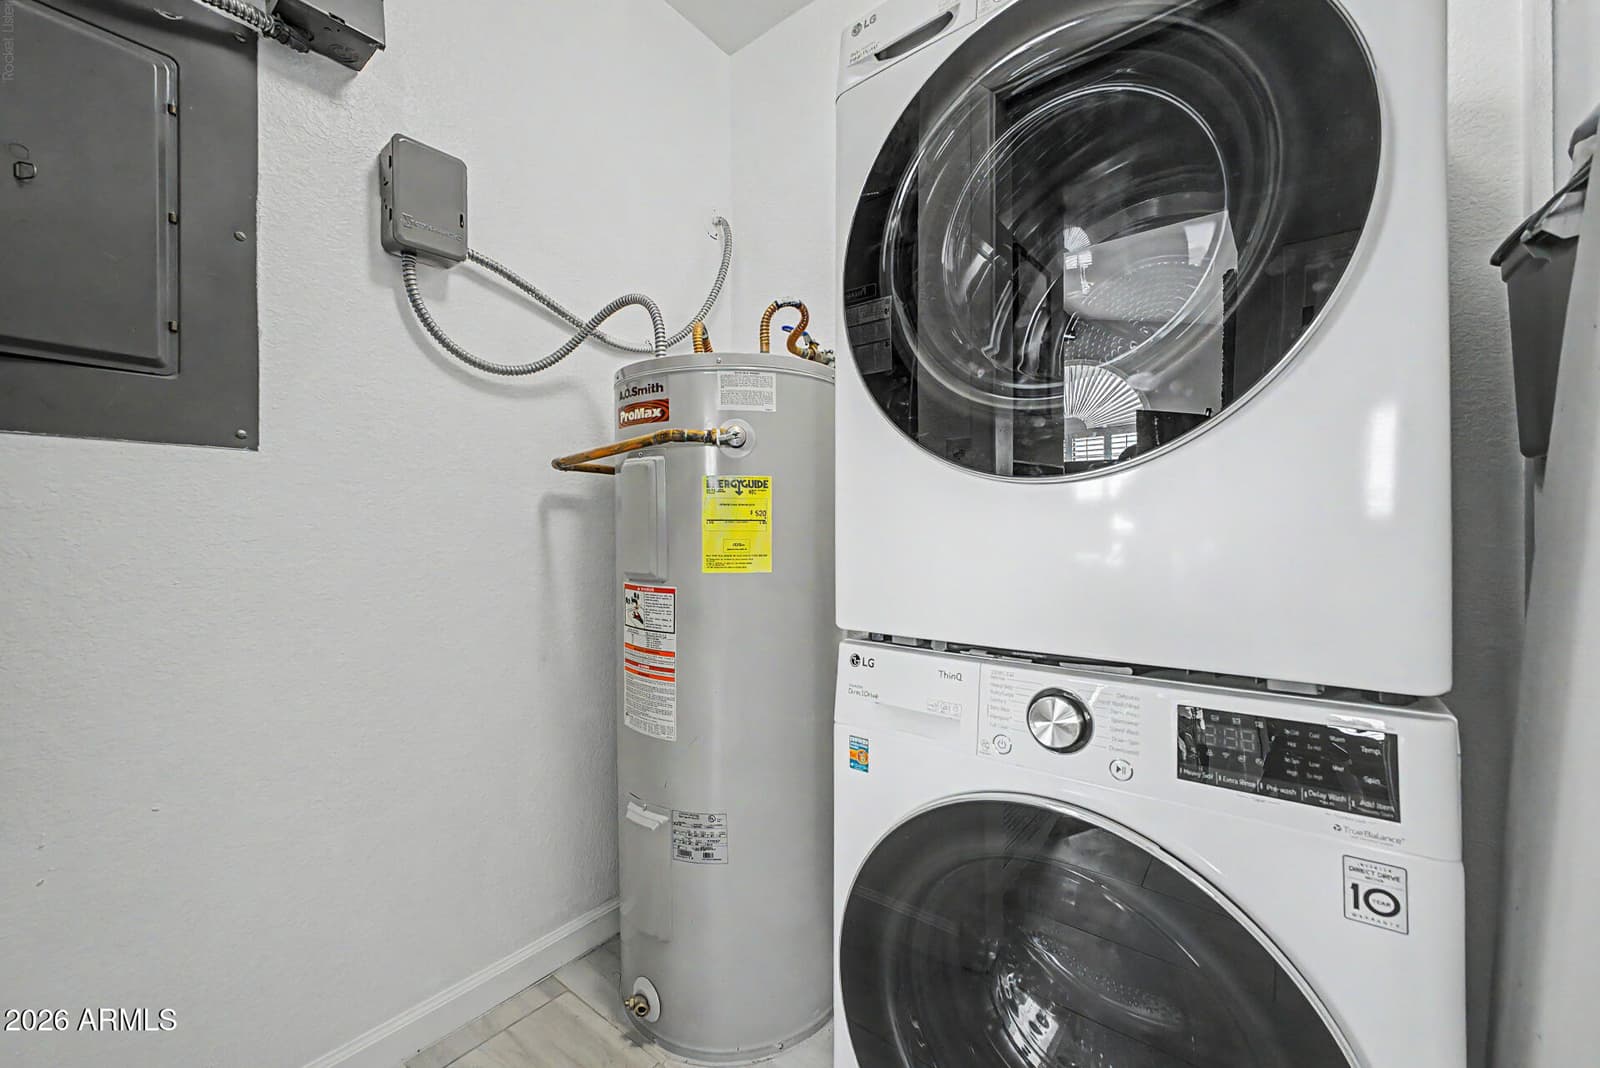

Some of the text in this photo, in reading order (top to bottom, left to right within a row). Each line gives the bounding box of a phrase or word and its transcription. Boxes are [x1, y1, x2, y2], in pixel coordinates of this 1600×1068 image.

[863, 14, 877, 29] LG
[620, 407, 663, 424] ProMax
[706, 479, 769, 490] ERGYGUIDE
[862, 657, 875, 668] LG
[938, 670, 964, 682] ThinQ
[1222, 776, 1238, 785] Extra
[1363, 775, 1381, 785] Spin
[1308, 789, 1328, 801] Delay
[1360, 799, 1375, 809] Add
[1349, 865, 1375, 876] DIRECT
[1377, 872, 1400, 883] DRIVE
[1351, 882, 1401, 917] 10
[1372, 898, 1392, 908] YEAR
